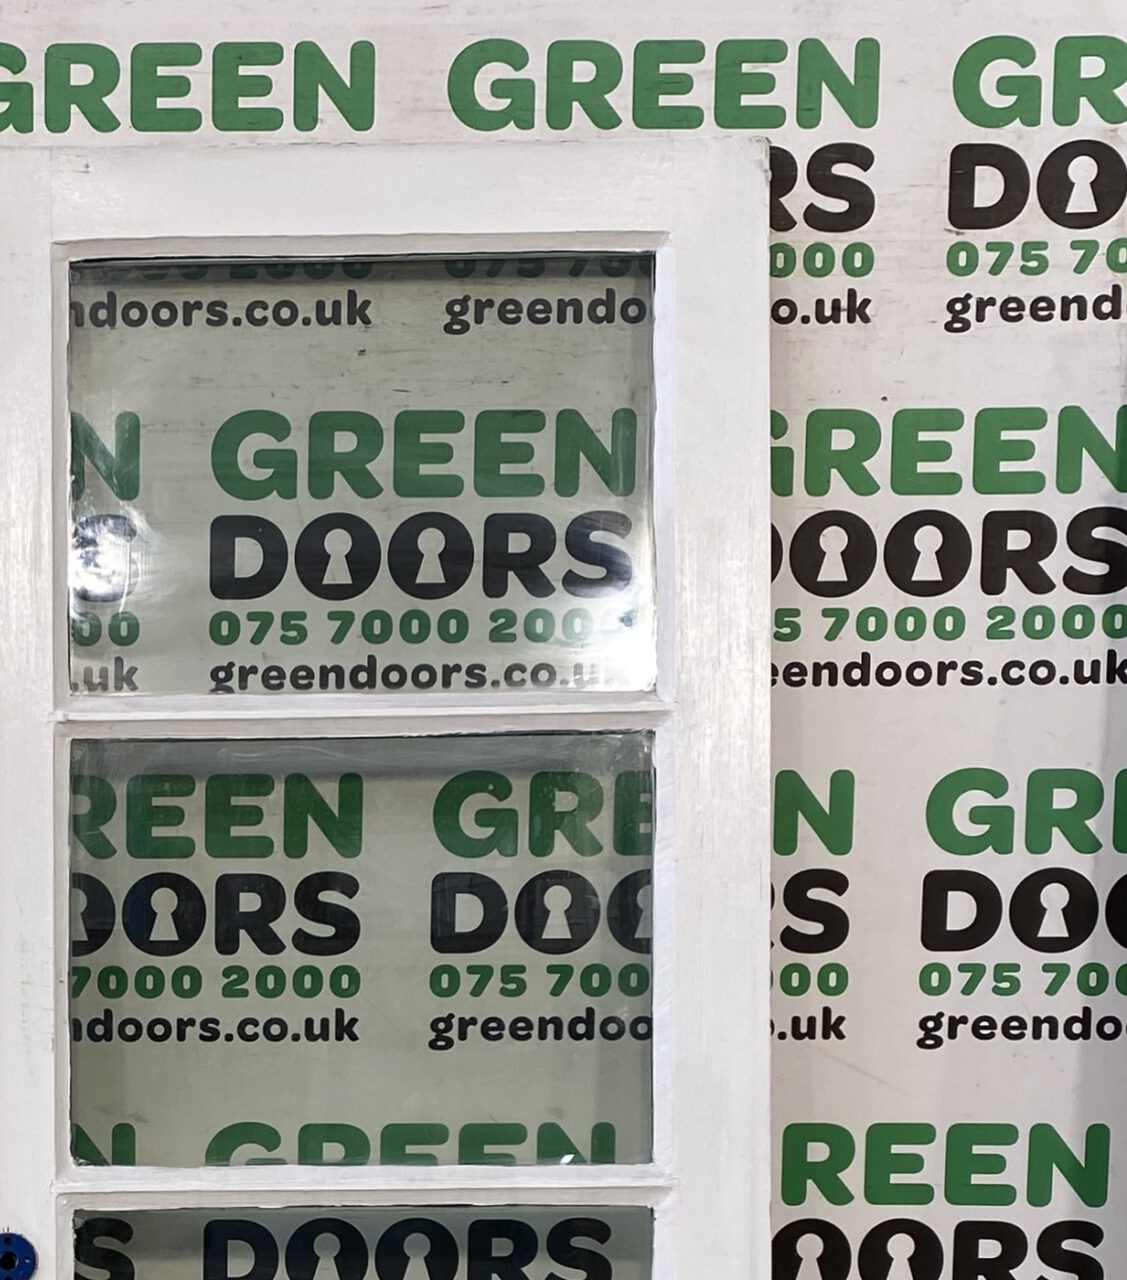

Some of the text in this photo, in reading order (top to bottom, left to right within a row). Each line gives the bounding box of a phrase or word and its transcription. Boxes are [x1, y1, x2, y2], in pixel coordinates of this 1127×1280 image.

[447, 38, 881, 132] GREEN
[946, 239, 1127, 278] 075 70
[211, 409, 637, 499] GREEN
[770, 405, 1127, 499] REEN
[210, 512, 632, 600] DOORS
[770, 508, 1127, 598] OORS
[210, 608, 594, 646] 075 7000 200
[822, 604, 1127, 641] 7000 2000
[221, 965, 361, 999] 2000
[429, 964, 650, 998] 075 700
[918, 963, 1021, 996] 075
[781, 1122, 1110, 1208] REEN
